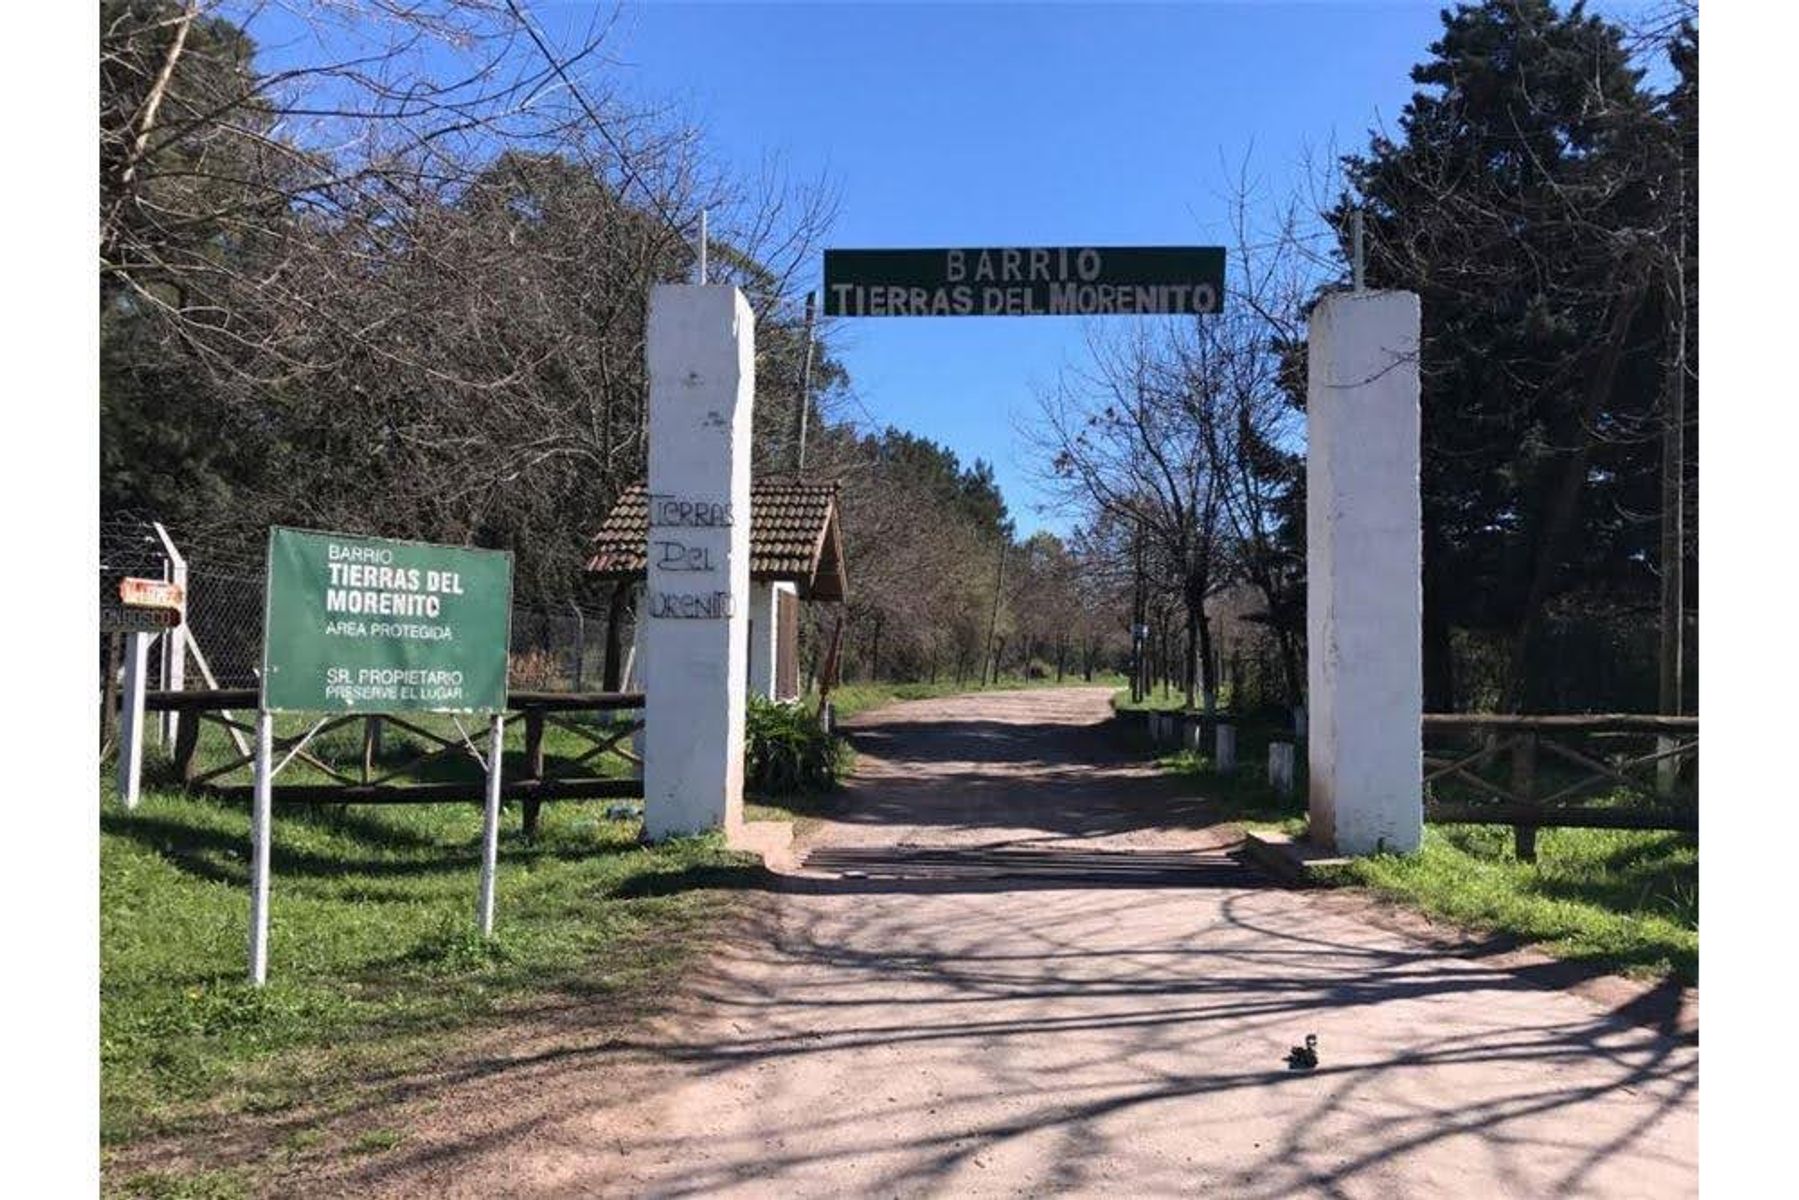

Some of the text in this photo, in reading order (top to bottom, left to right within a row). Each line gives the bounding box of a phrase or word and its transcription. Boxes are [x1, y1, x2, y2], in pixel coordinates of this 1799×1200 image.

[948, 248, 1101, 282] BARRIO
[832, 282, 1216, 316] TIERRAS DEL MORENITO
[328, 544, 392, 564] BARRIO
[328, 563, 463, 594] TIERRAS DEL
[327, 589, 440, 618] MORENITO
[326, 621, 453, 640] AREA PROTEGIDA
[359, 669, 463, 686] PROPIETARIO
[326, 686, 462, 701] PRESERVE EL LUGAR
